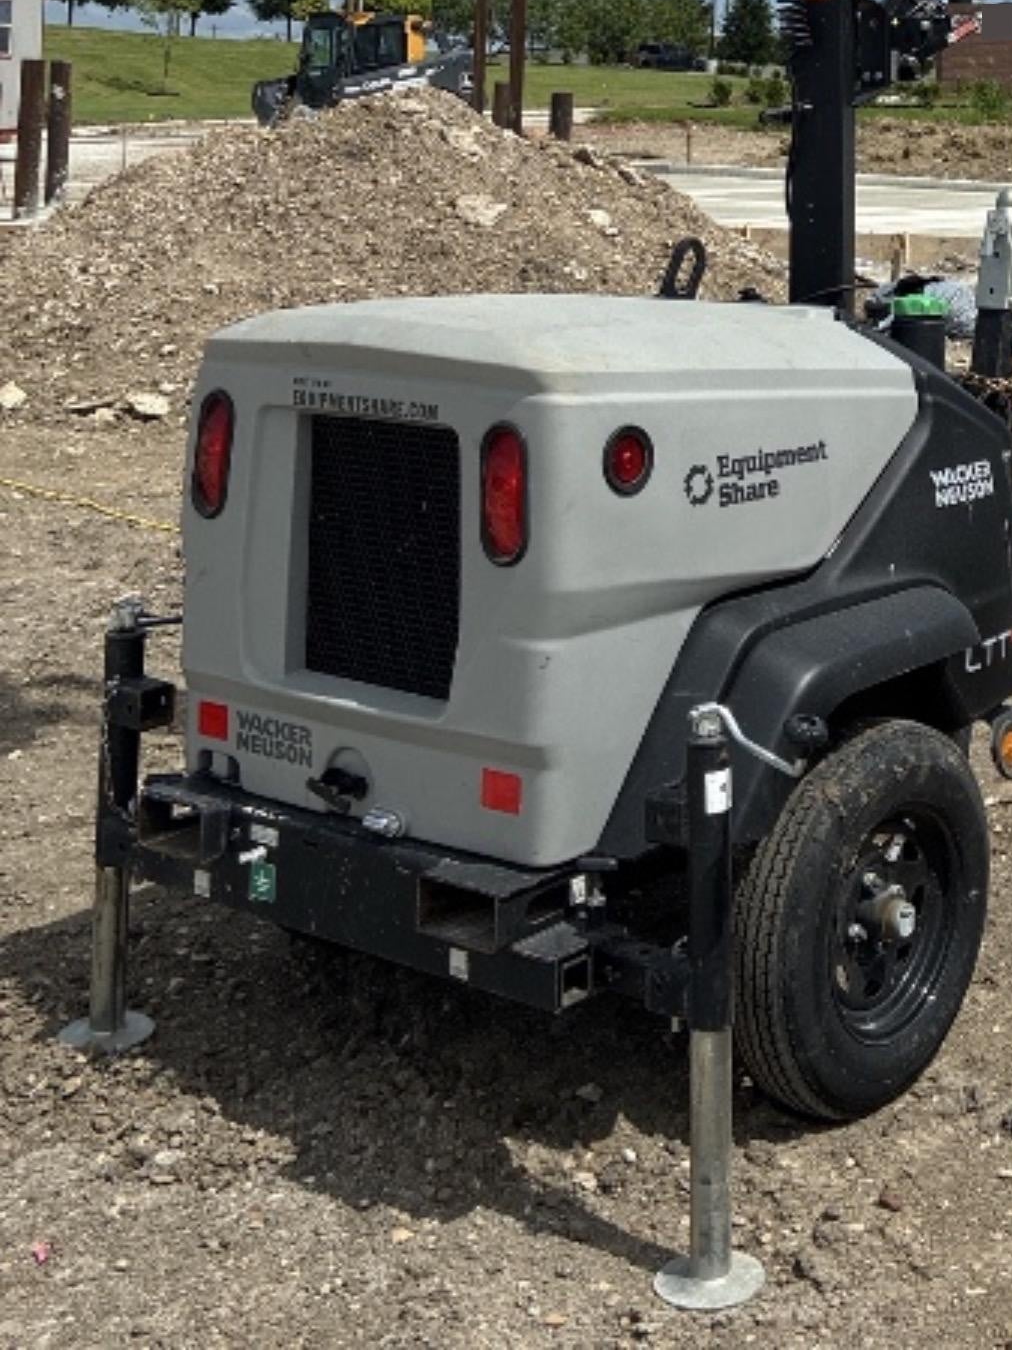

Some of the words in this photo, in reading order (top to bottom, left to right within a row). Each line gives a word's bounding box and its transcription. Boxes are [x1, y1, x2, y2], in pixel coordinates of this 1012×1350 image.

[717, 440, 828, 480] Equipment
[719, 479, 780, 508] Share
[236, 711, 312, 747] WACKER
[236, 732, 313, 769] NEUSON
